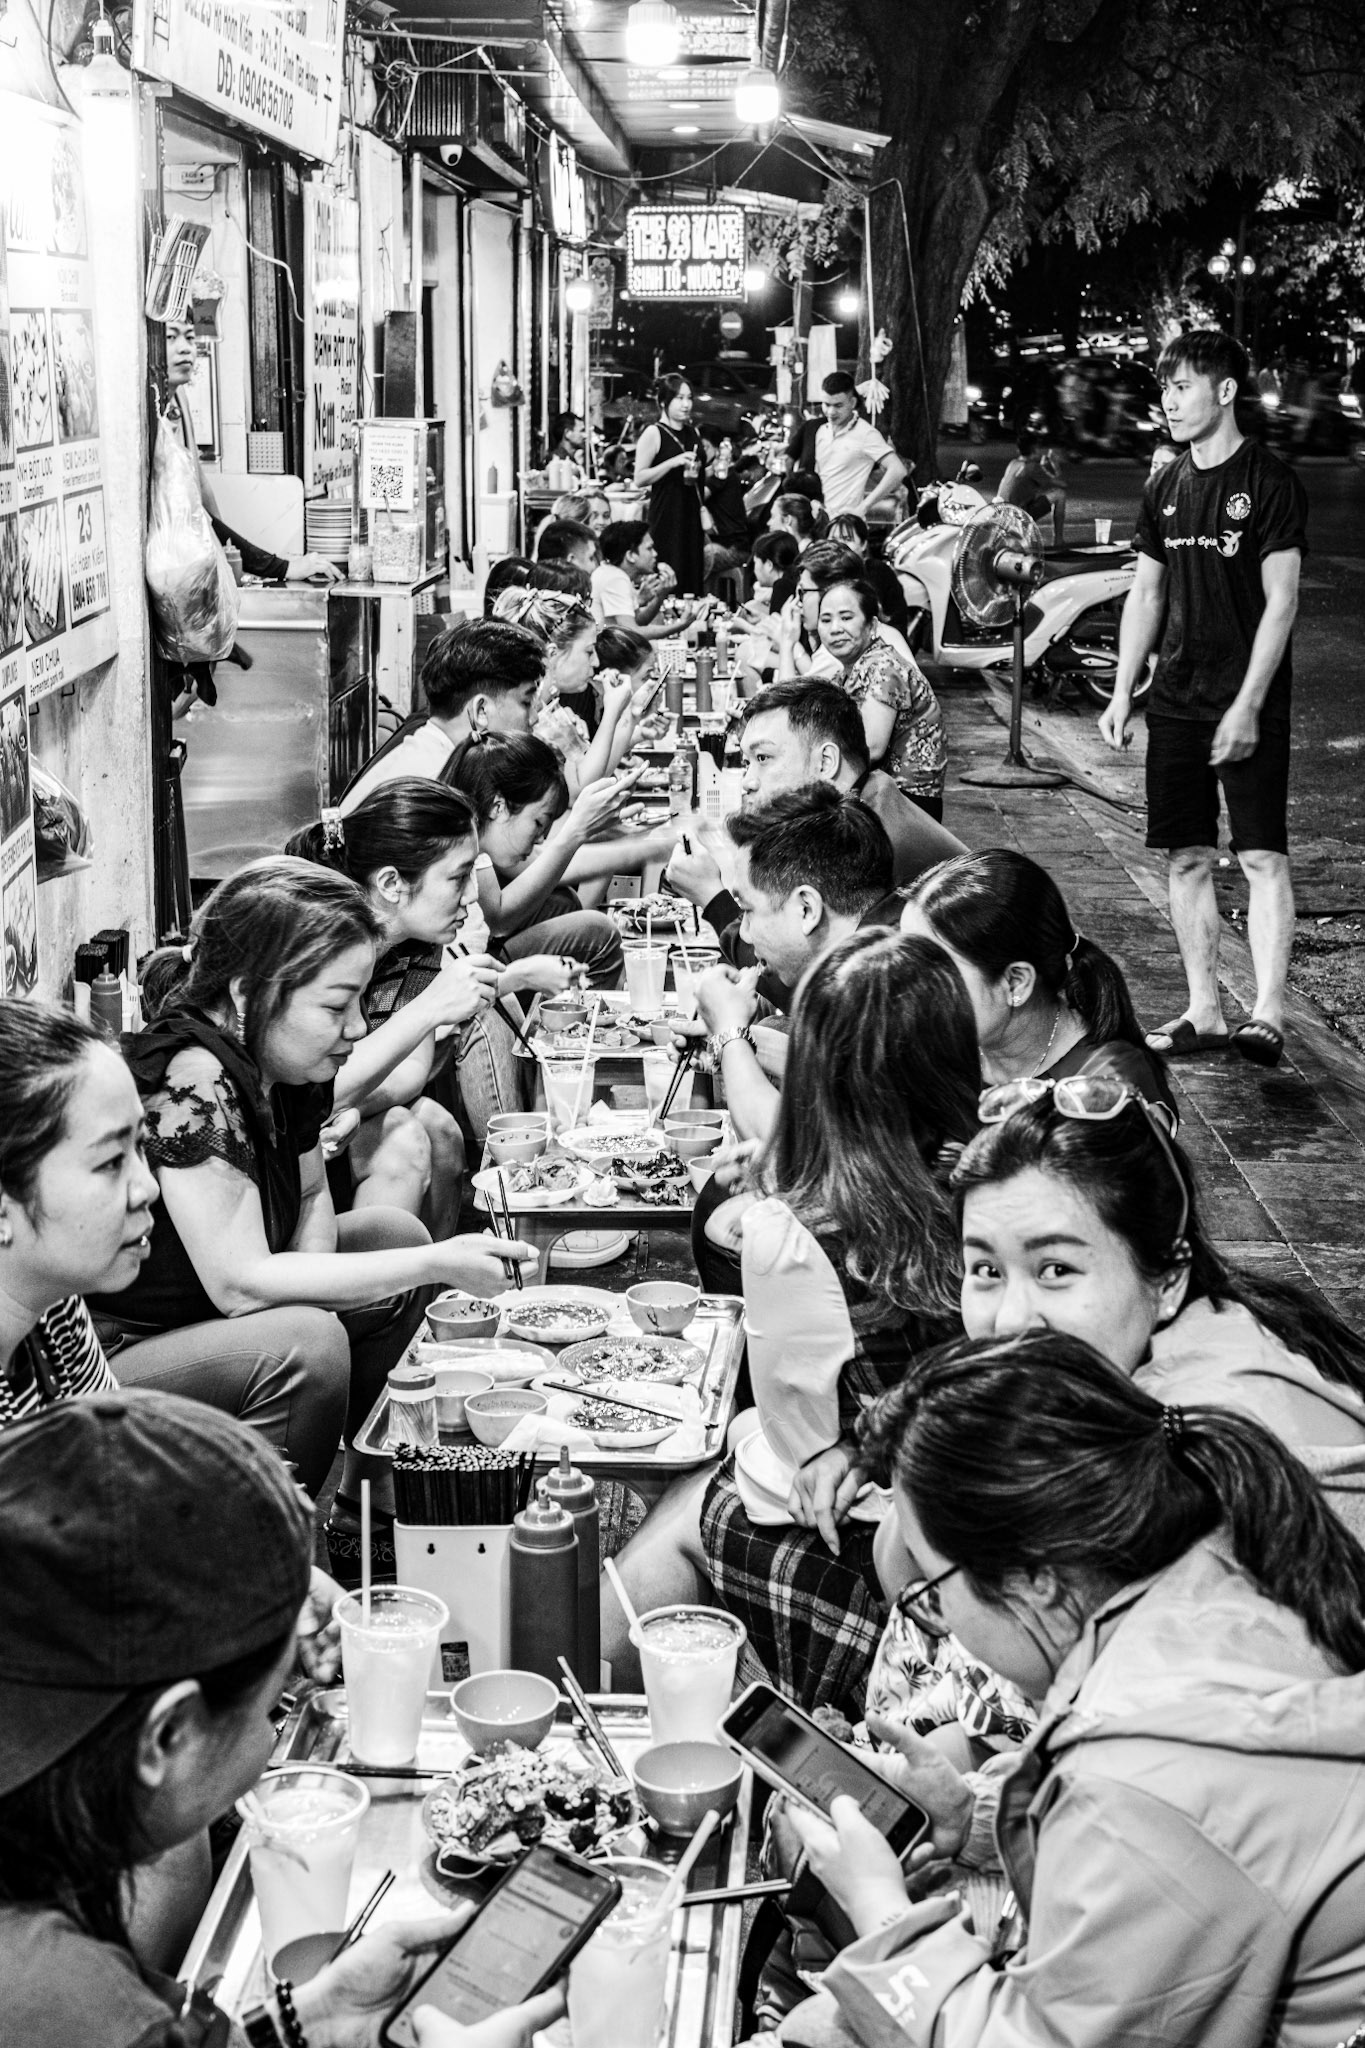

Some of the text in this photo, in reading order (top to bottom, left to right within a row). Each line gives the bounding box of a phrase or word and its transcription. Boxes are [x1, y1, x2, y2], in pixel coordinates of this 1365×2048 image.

[239, 63, 294, 130] 0904656708
[632, 214, 667, 260] THE
[691, 213, 740, 260] KAFE
[632, 265, 664, 290] SINH
[686, 260, 721, 290] NƯỚC
[722, 260, 740, 290] ÉP
[314, 383, 335, 452] Nem
[77, 501, 93, 545] 23
